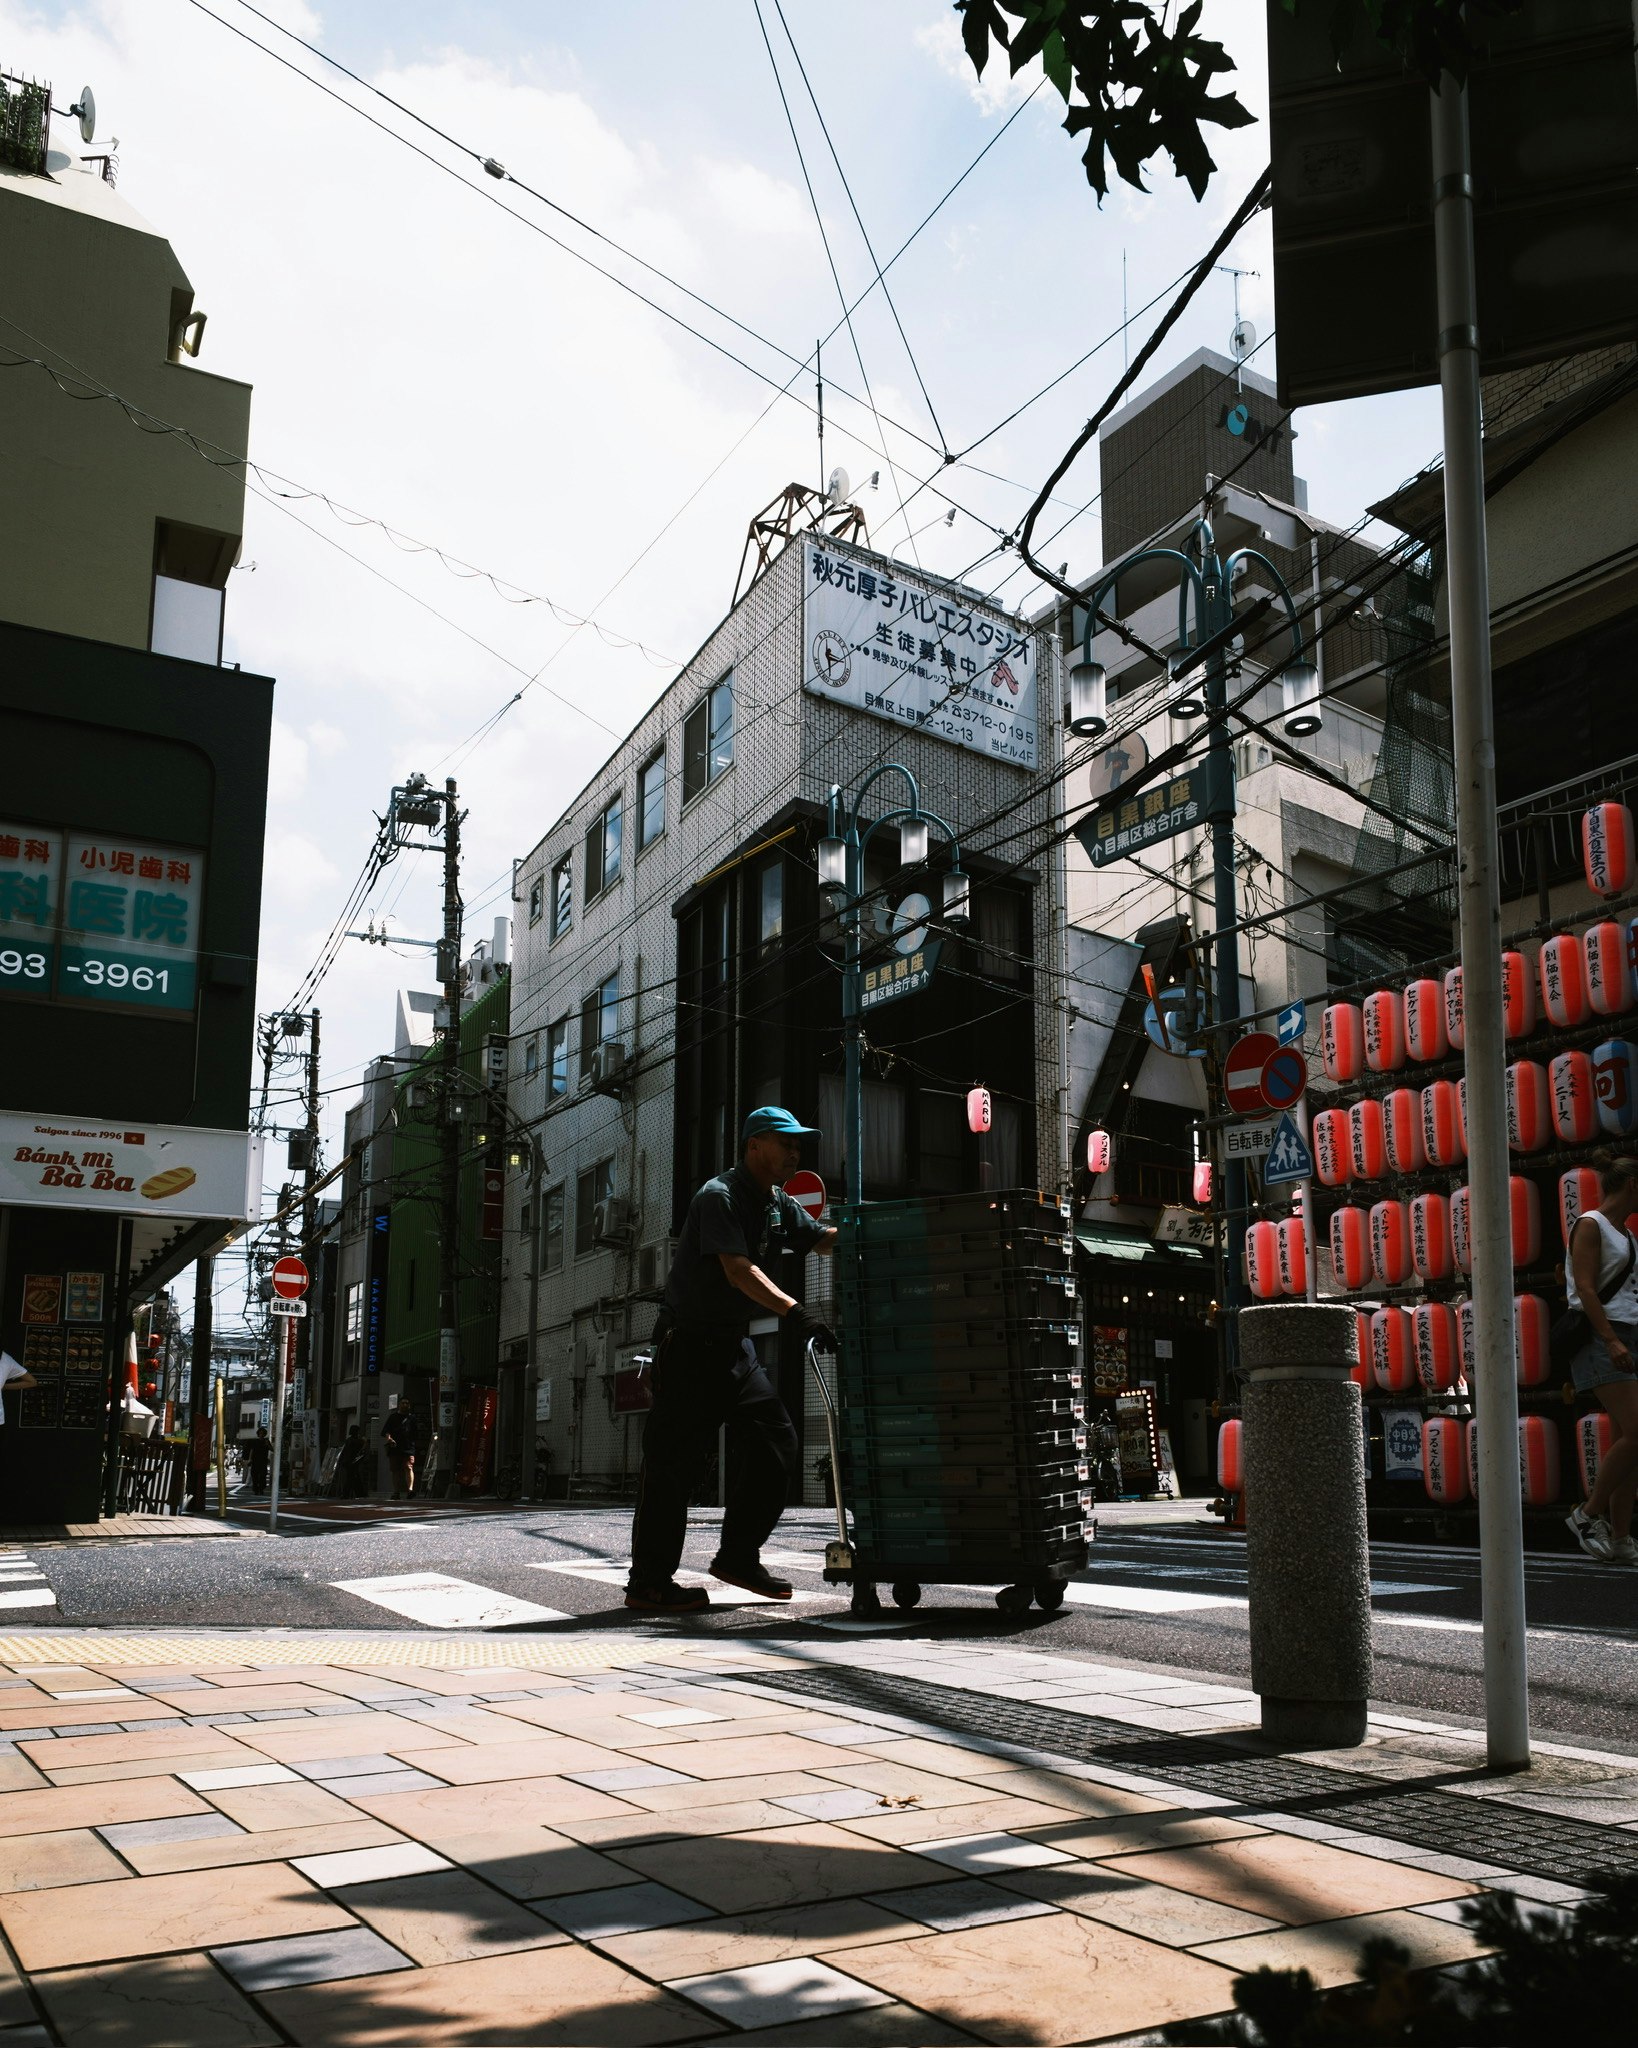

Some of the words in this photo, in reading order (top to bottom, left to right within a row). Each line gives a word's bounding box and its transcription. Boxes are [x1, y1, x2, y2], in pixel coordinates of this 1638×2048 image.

[812, 552, 1030, 665] 秋元厚子バレエスタジオ
[876, 621, 977, 677] 生徒募集中
[991, 737, 1033, 762] 当ビル4F
[1097, 778, 1190, 839] 目黒銀座
[1104, 801, 1198, 855] 目黒区総合庁舎
[80, 846, 191, 884] 小児歯科
[865, 952, 924, 991] 目黒銀座
[1545, 949, 1561, 1001] 創価学会
[1587, 936, 1601, 989] 創価学会
[861, 973, 920, 1007] 目黒区総合庁舎
[1407, 989, 1418, 1044] セガフレード
[981, 1091, 990, 1124] MARU
[34, 1125, 69, 1136] Saigon
[72, 1129, 97, 1138] since
[99, 1131, 122, 1140] 1996
[1099, 1134, 1107, 1166] クリスタル
[1229, 1128, 1276, 1151] 自転車を
[13, 1146, 76, 1166] Bánh
[81, 1151, 114, 1169] Mì
[39, 1164, 86, 1188] Bà
[90, 1169, 136, 1192] Ba
[1413, 1202, 1427, 1267] 東京共済病院
[73, 1275, 99, 1284] かき氷
[273, 1301, 304, 1314] 自転車を除く
[367, 1277, 381, 1373] NAKAMEGURO
[1392, 1429, 1416, 1441] 中目黒
[1393, 1442, 1418, 1453] 夏まつり
[1430, 1428, 1441, 1492] つるさん薬局
[1584, 1420, 1596, 1494] 日本街路灯製造
